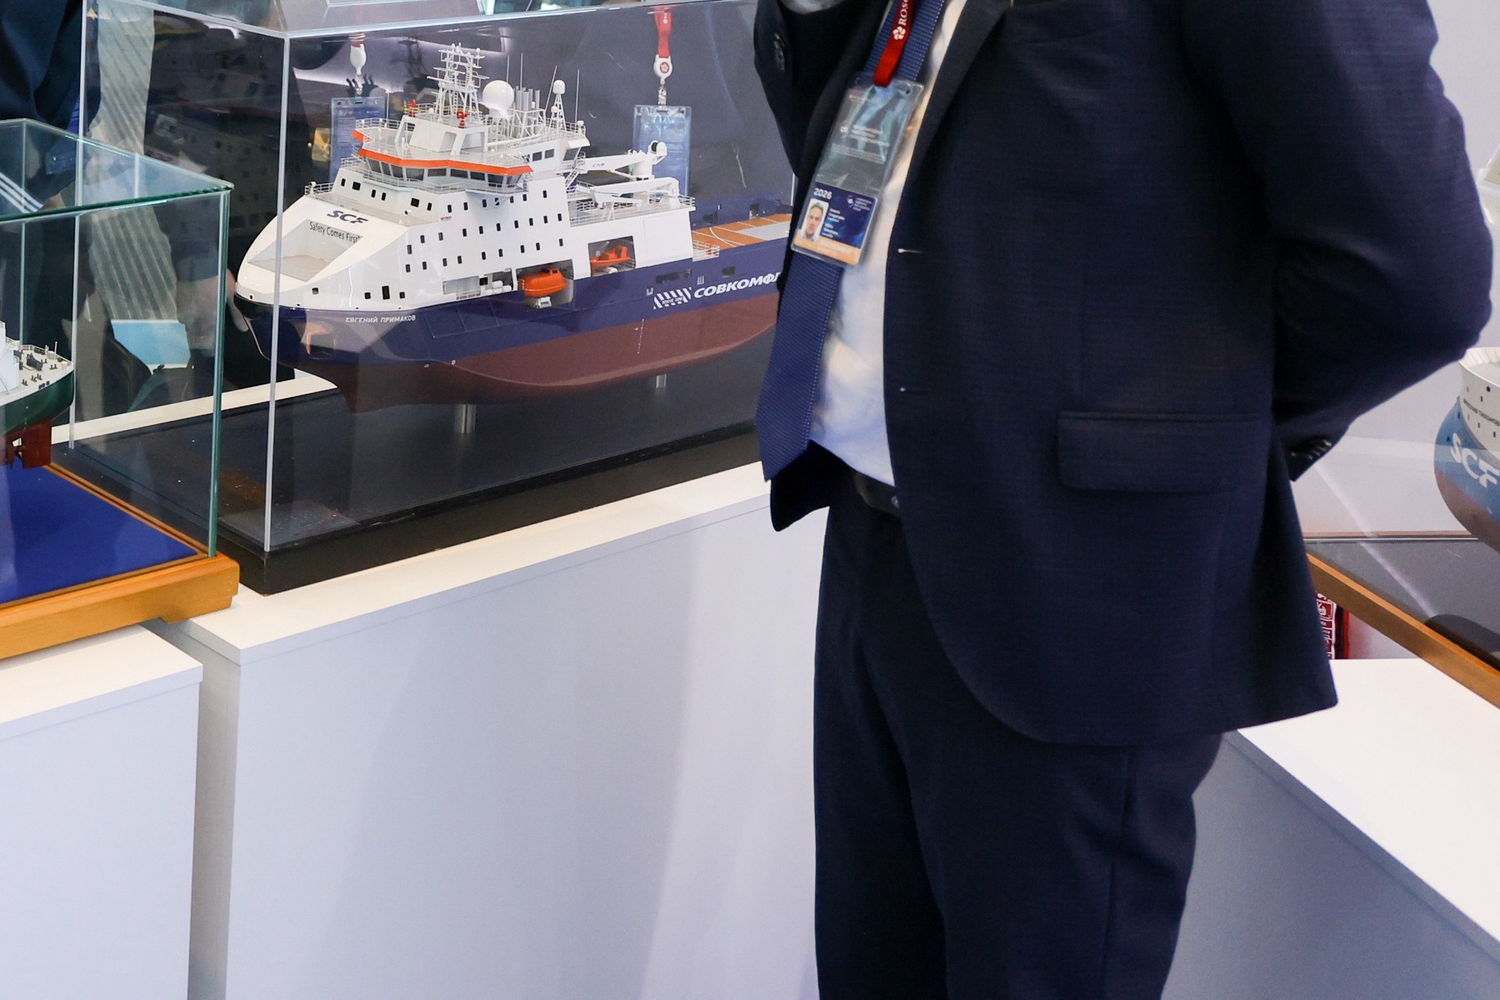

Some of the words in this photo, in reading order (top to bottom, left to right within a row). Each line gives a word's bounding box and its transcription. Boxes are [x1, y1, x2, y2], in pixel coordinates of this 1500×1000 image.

[813, 187, 833, 200] 2026
[327, 210, 369, 223] SCF
[309, 221, 326, 235] Safety
[326, 226, 345, 240] Comes
[380, 314, 416, 323] ПРИМАКОВ
[1450, 432, 1500, 488] SCF
